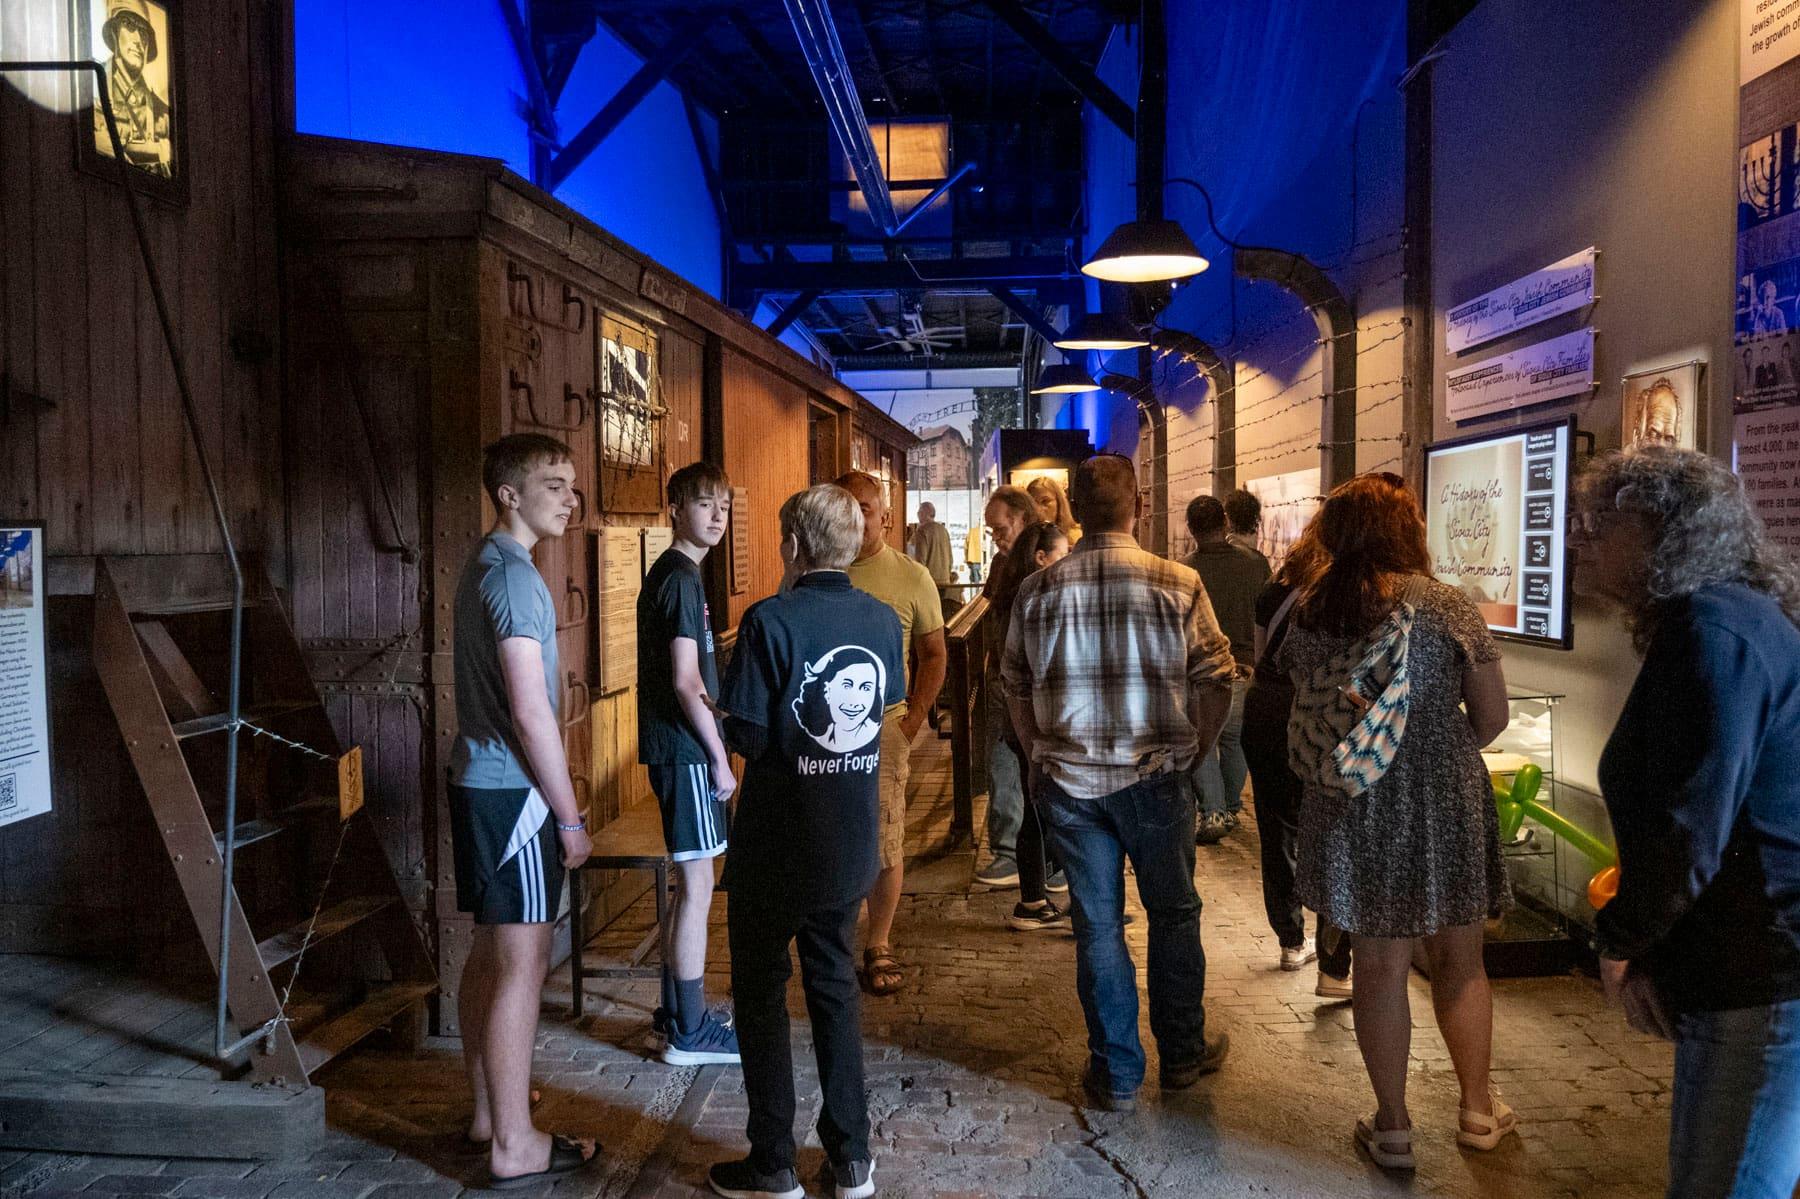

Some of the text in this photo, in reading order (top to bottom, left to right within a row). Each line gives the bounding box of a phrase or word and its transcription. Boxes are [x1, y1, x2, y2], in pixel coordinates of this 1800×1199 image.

[1749, 13, 1775, 37] Jewish
[1752, 40, 1764, 55] the
[1765, 24, 1791, 50] growth
[679, 421, 689, 442] DR
[1746, 424, 1766, 437] From
[1767, 422, 1780, 434] the
[1786, 439, 1799, 451] the
[1778, 460, 1796, 470] now
[1489, 479, 1503, 498] the
[1473, 519, 1490, 558] City
[1457, 557, 1512, 598] Community
[798, 755, 842, 775] Never
